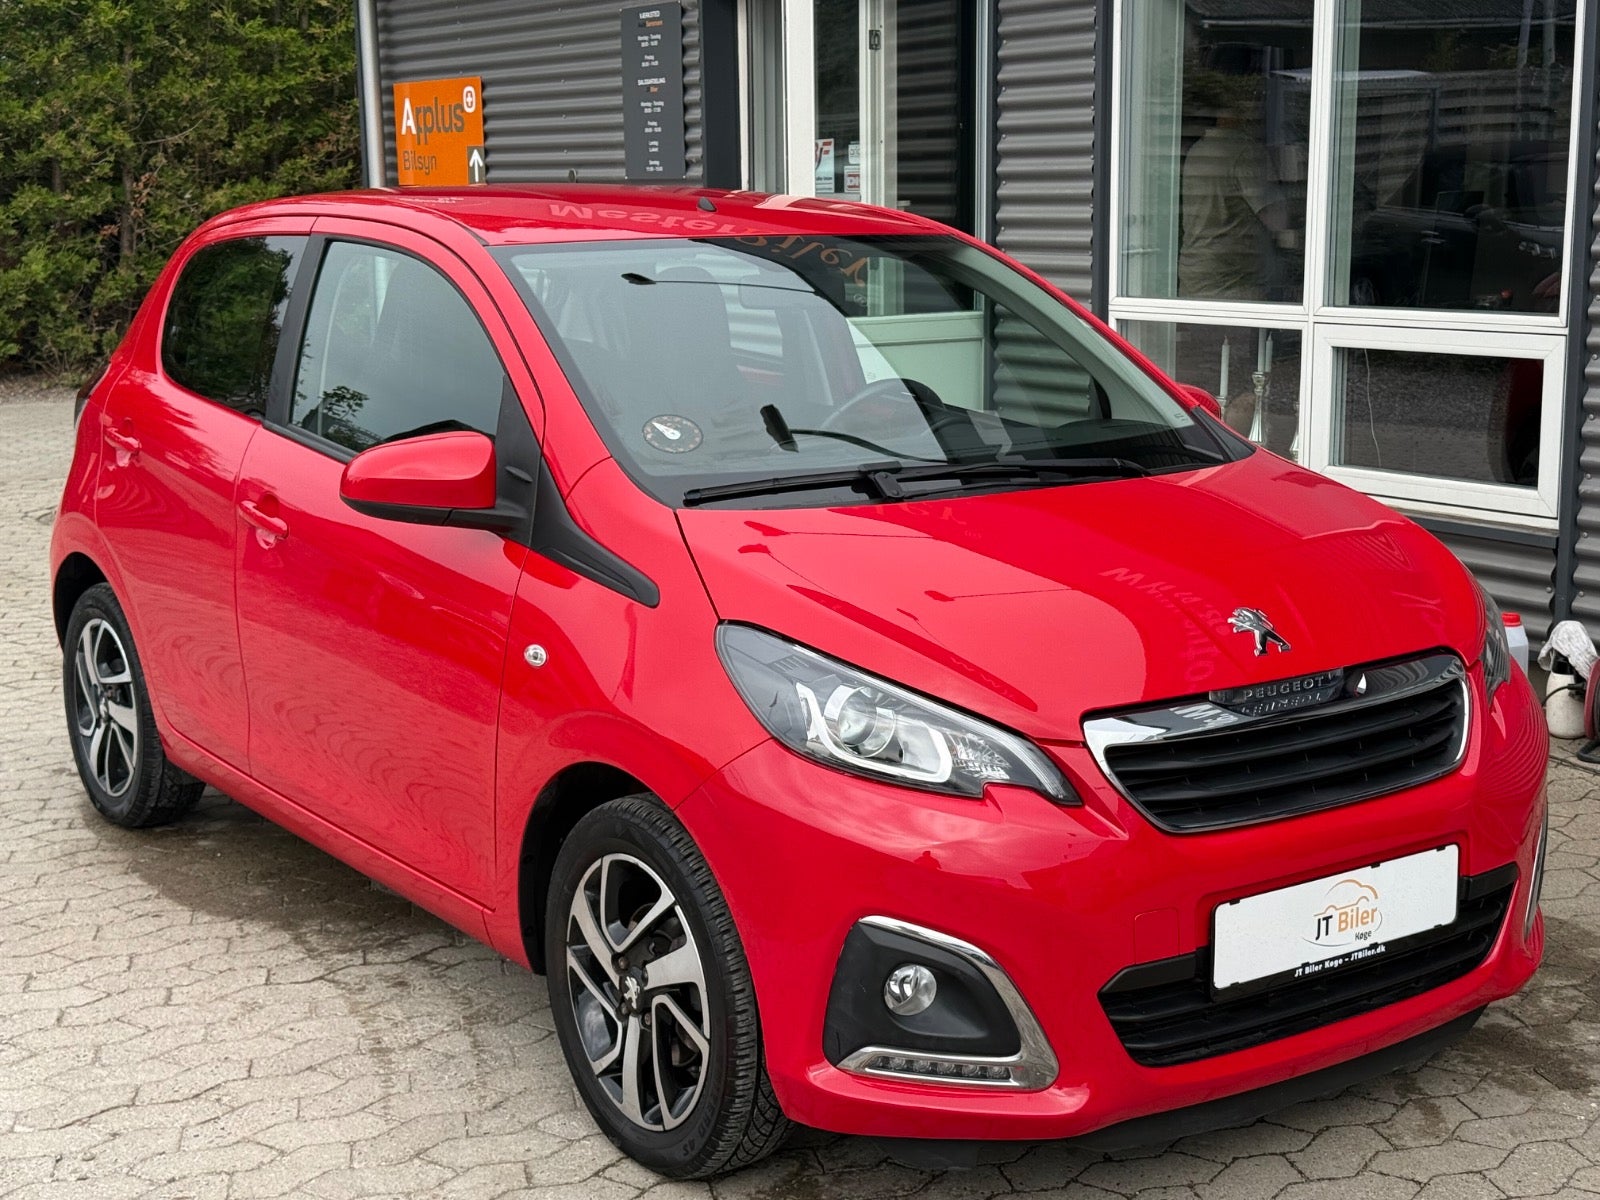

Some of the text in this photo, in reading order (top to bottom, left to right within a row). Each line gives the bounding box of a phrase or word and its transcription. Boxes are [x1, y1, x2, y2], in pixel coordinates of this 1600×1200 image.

[402, 150, 438, 176] Bilsyn
[1244, 675, 1325, 700] PEUGEOT
[1315, 906, 1378, 941] JT Biler
[1354, 930, 1373, 942] Køge
[1294, 968, 1304, 978] JT
[1304, 963, 1323, 975] Biler
[1351, 945, 1386, 961] JTBiler.dk
